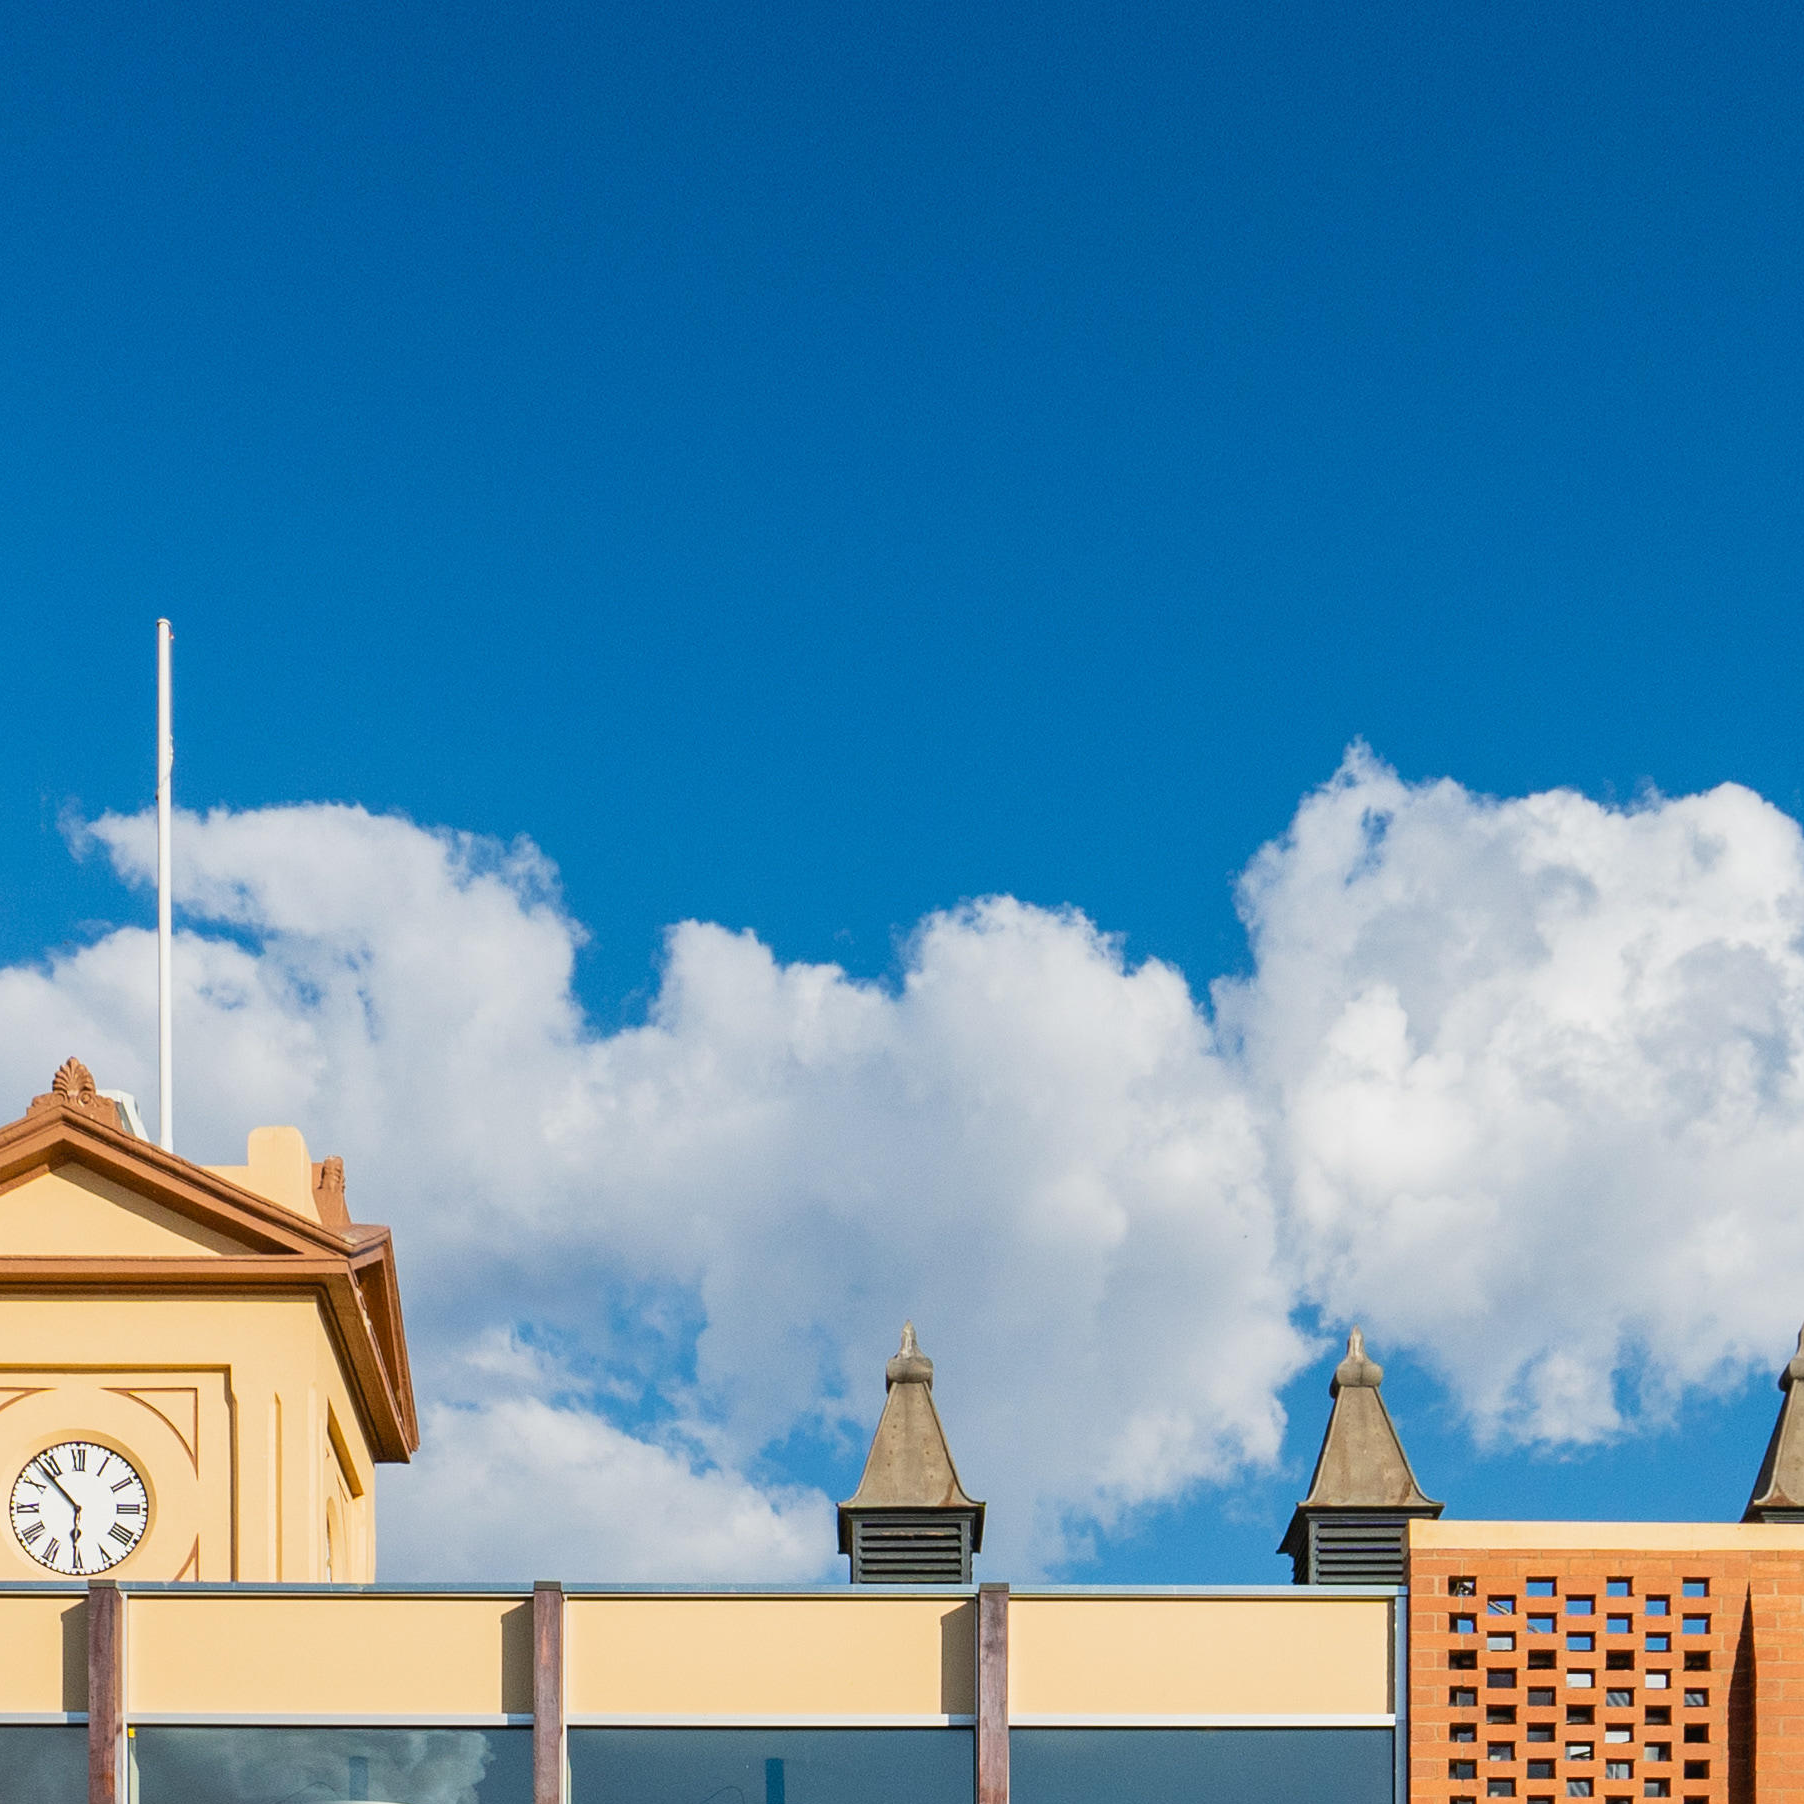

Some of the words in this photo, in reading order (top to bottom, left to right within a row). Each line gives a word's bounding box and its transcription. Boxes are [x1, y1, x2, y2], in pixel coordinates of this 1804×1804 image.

[71, 1449, 86, 1472] XII
[110, 1476, 133, 1493] II
[116, 1504, 140, 1514] III
